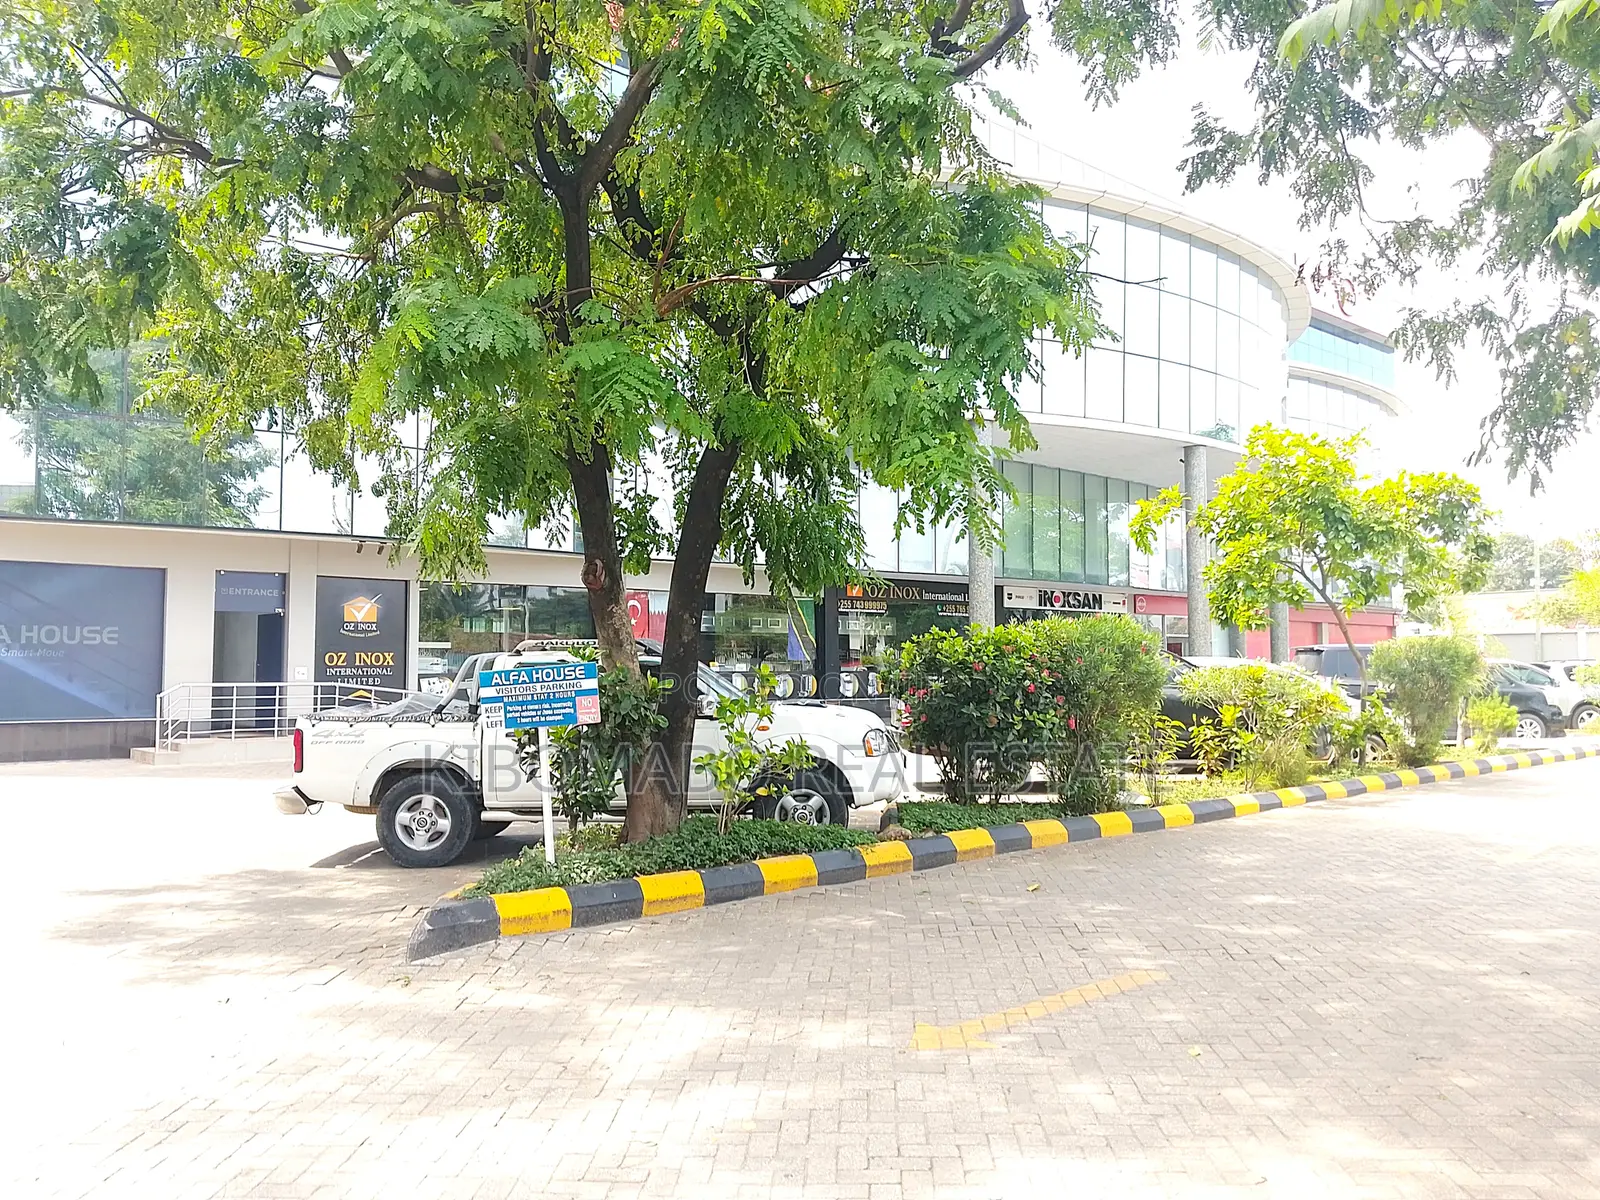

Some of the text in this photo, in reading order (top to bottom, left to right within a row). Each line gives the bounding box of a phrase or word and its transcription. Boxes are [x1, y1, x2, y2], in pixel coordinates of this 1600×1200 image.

[228, 587, 279, 597] ENTRANCE
[868, 585, 887, 599] OZ
[890, 586, 921, 600] INOX
[922, 589, 965, 602] International
[344, 622, 377, 630] OZ INOX
[20, 624, 119, 645] HOUSE
[0, 647, 33, 657] Smart
[325, 652, 394, 666] OZ INOX
[326, 667, 393, 676] INTERNATIONAL
[491, 666, 586, 686] ALFA HOUSE
[337, 677, 381, 685] LIMITED
[495, 681, 583, 696] VISITORS PARKING
[503, 695, 532, 703] MAXIMUM
[581, 698, 593, 707] NO
[485, 706, 503, 714] KEEP
[486, 720, 503, 728] LEFT
